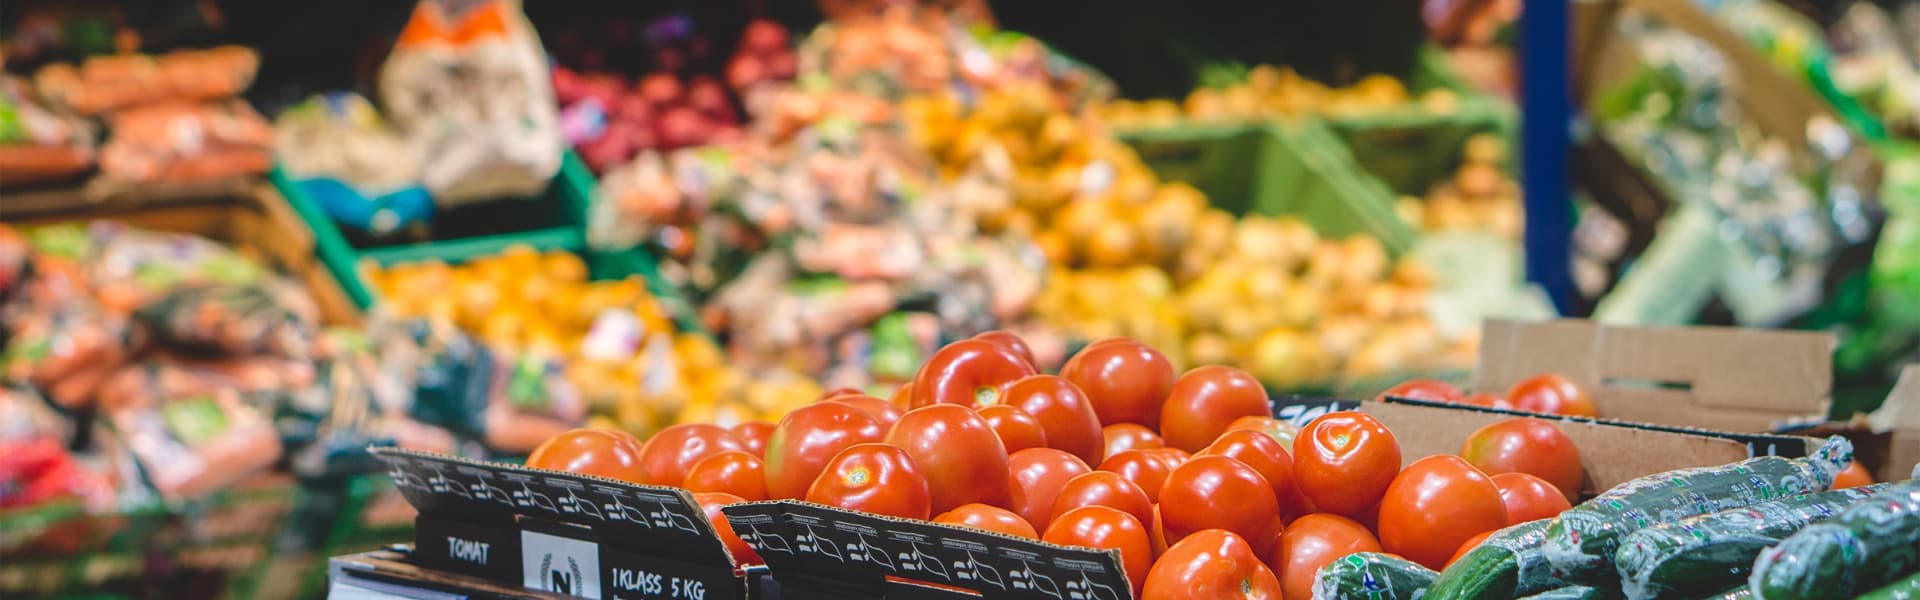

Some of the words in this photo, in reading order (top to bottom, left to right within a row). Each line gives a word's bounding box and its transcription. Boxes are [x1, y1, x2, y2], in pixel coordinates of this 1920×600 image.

[447, 536, 491, 566] TOMAT
[620, 568, 662, 595] KLASS
[671, 577, 681, 598] 5
[683, 579, 706, 600] KG
